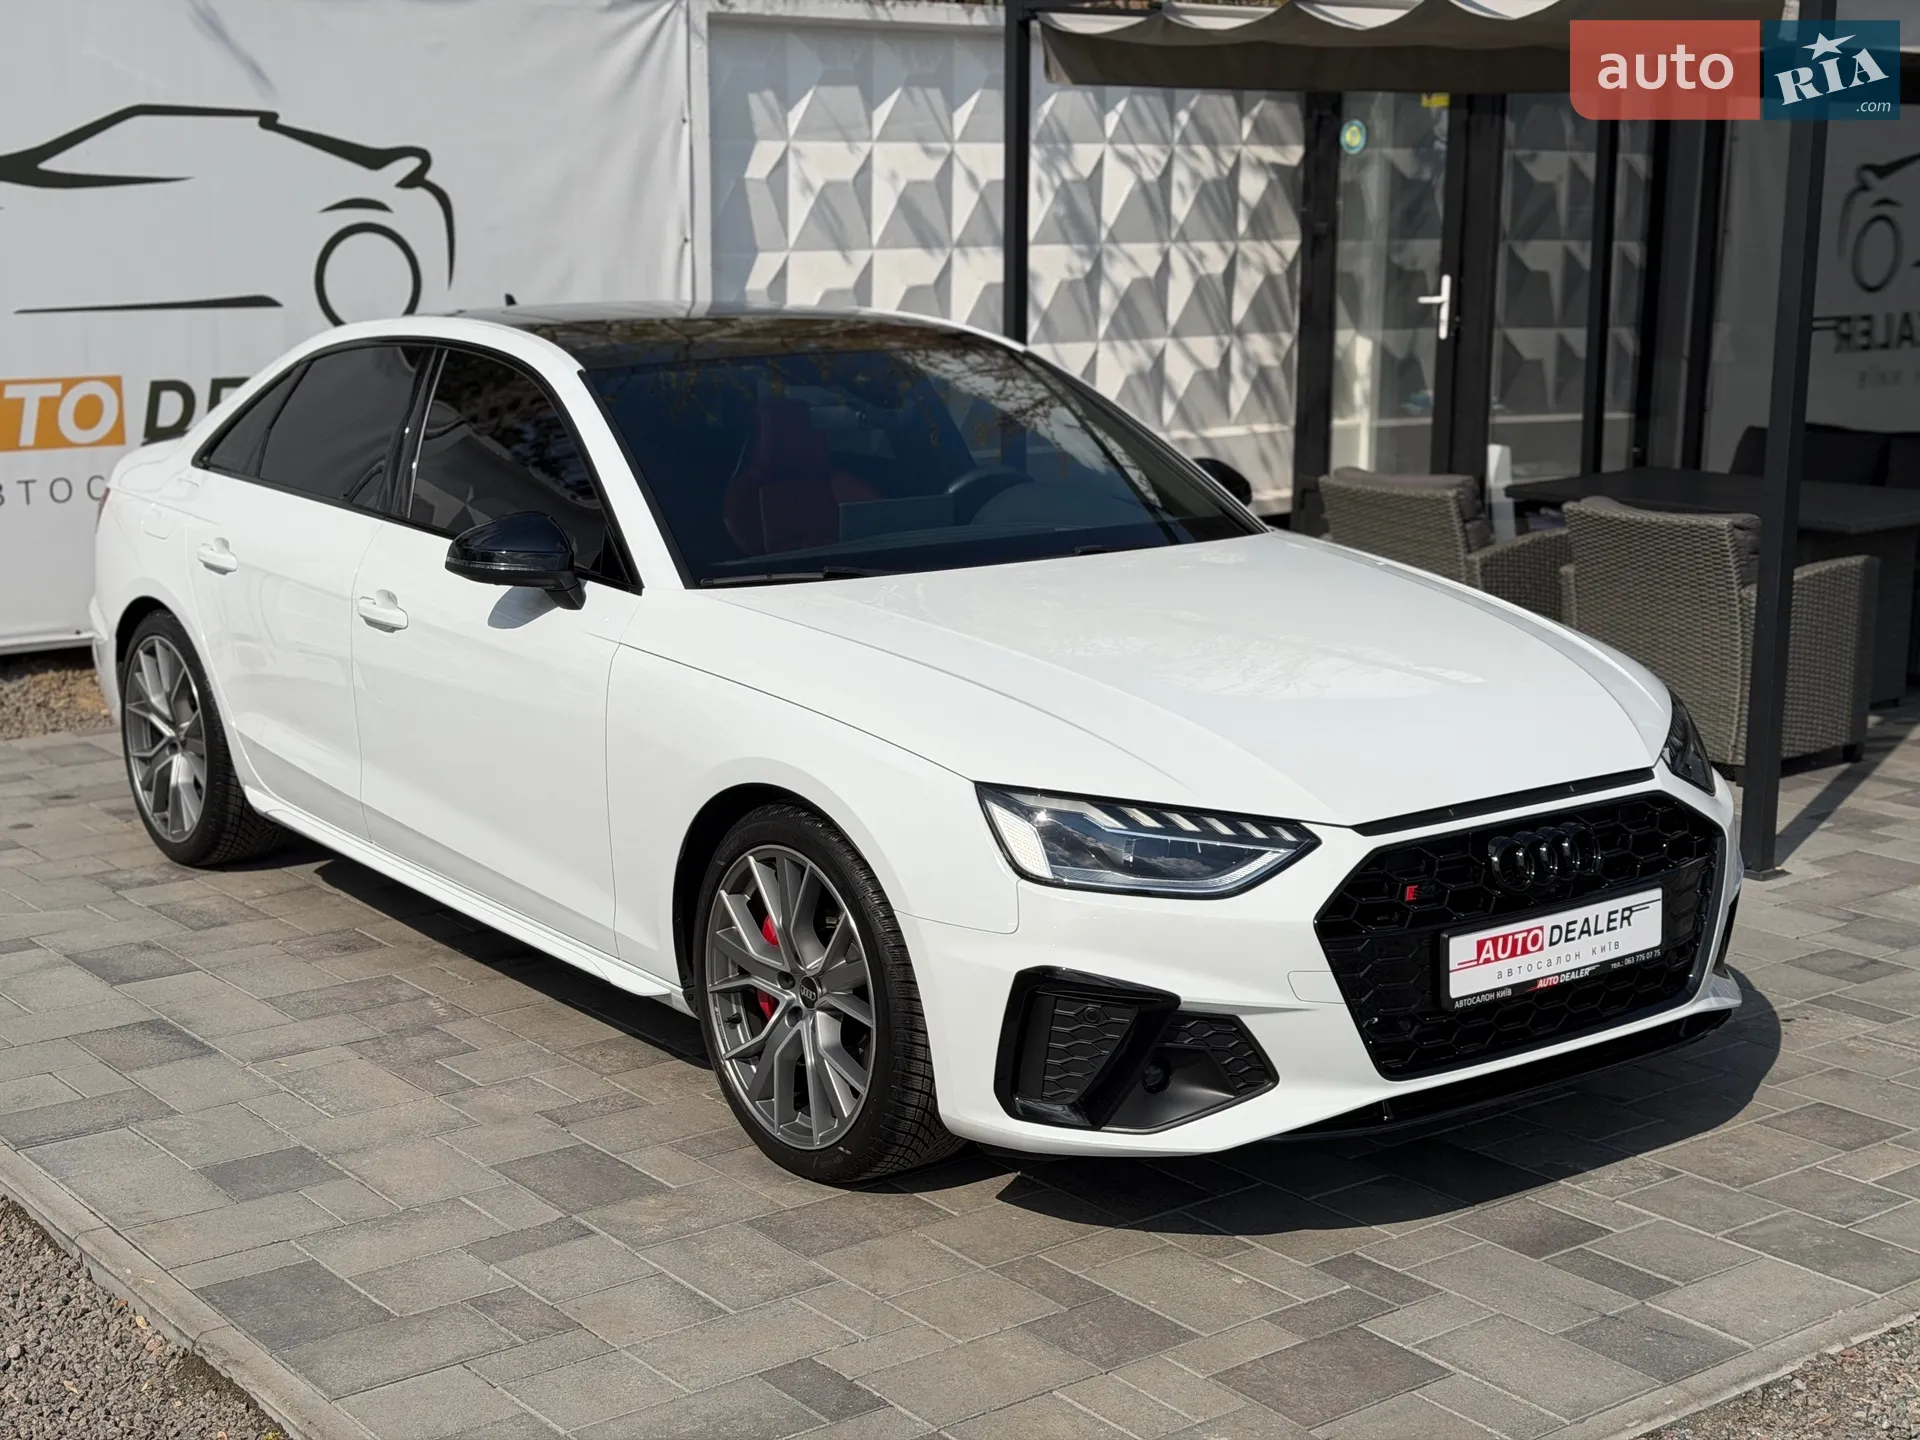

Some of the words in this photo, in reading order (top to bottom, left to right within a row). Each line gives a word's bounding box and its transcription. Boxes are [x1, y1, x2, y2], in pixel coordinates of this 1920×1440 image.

[0, 475, 105, 505] ТОС
[1479, 928, 1543, 964] AUTO
[1549, 907, 1632, 947] DEALER
[1497, 952, 1580, 979] автосалон
[1537, 975, 1559, 989] AUTO
[1560, 968, 1590, 983] DEALER
[1454, 991, 1495, 1009] АВТОСАЛОН
[1496, 987, 1512, 998] КИЇВ
